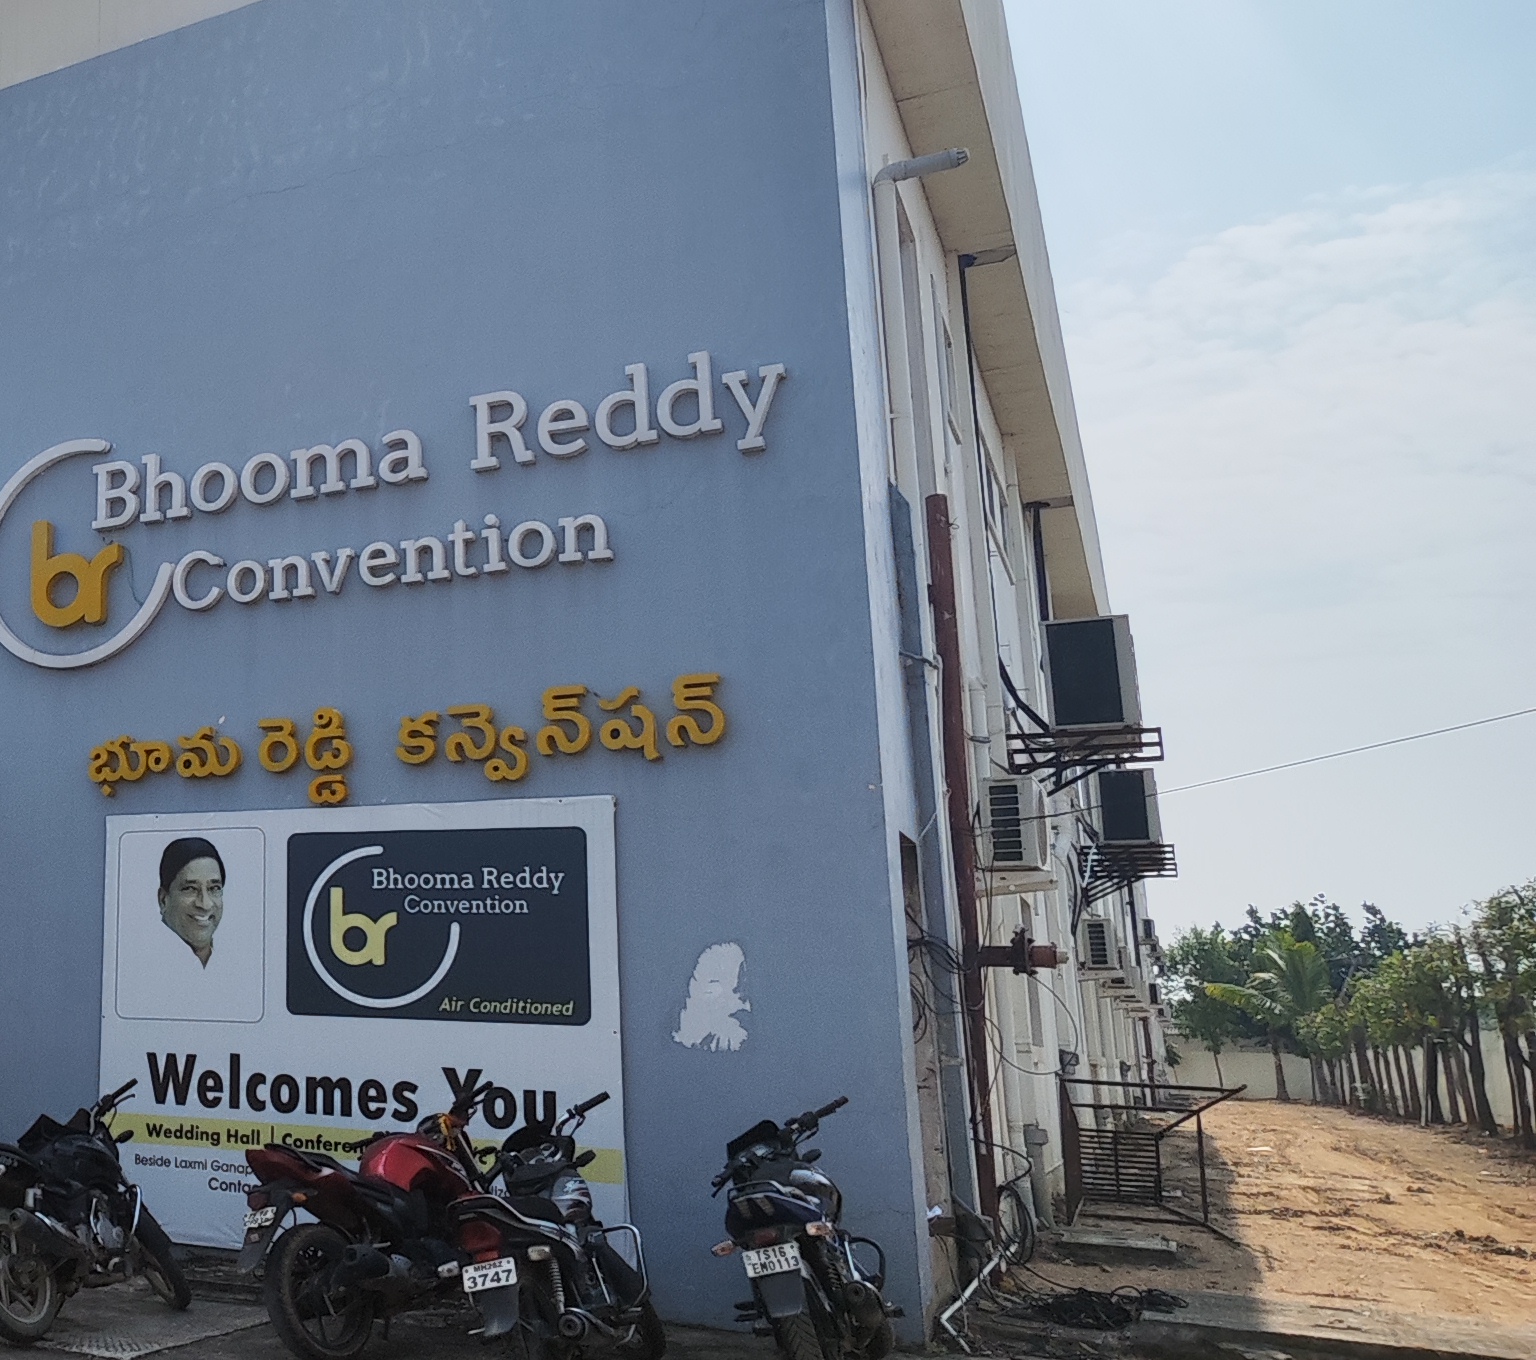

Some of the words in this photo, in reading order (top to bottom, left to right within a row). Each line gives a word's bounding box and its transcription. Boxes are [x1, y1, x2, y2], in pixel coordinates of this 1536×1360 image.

[91, 428, 429, 532] Bhooma
[468, 350, 787, 472] Reddy
[172, 512, 614, 611] Convention
[258, 707, 355, 803] రెడ్డి
[371, 868, 475, 889] Bhooma
[481, 866, 565, 895] Reddy
[403, 895, 529, 914] Convention
[438, 996, 464, 1013] Air
[469, 997, 574, 1016] Conditioned
[146, 1051, 419, 1122] Welcomes
[441, 1066, 557, 1135] You
[145, 1122, 221, 1147] Wedding
[226, 1127, 261, 1146] Hall
[281, 1132, 365, 1155] Conferen
[134, 1153, 172, 1168] Beside
[174, 1156, 208, 1171] Laxmi
[210, 1159, 255, 1177] Ganap
[208, 1176, 265, 1194] Conta
[754, 1245, 787, 1262] TS16
[466, 1268, 513, 1290] 3747
